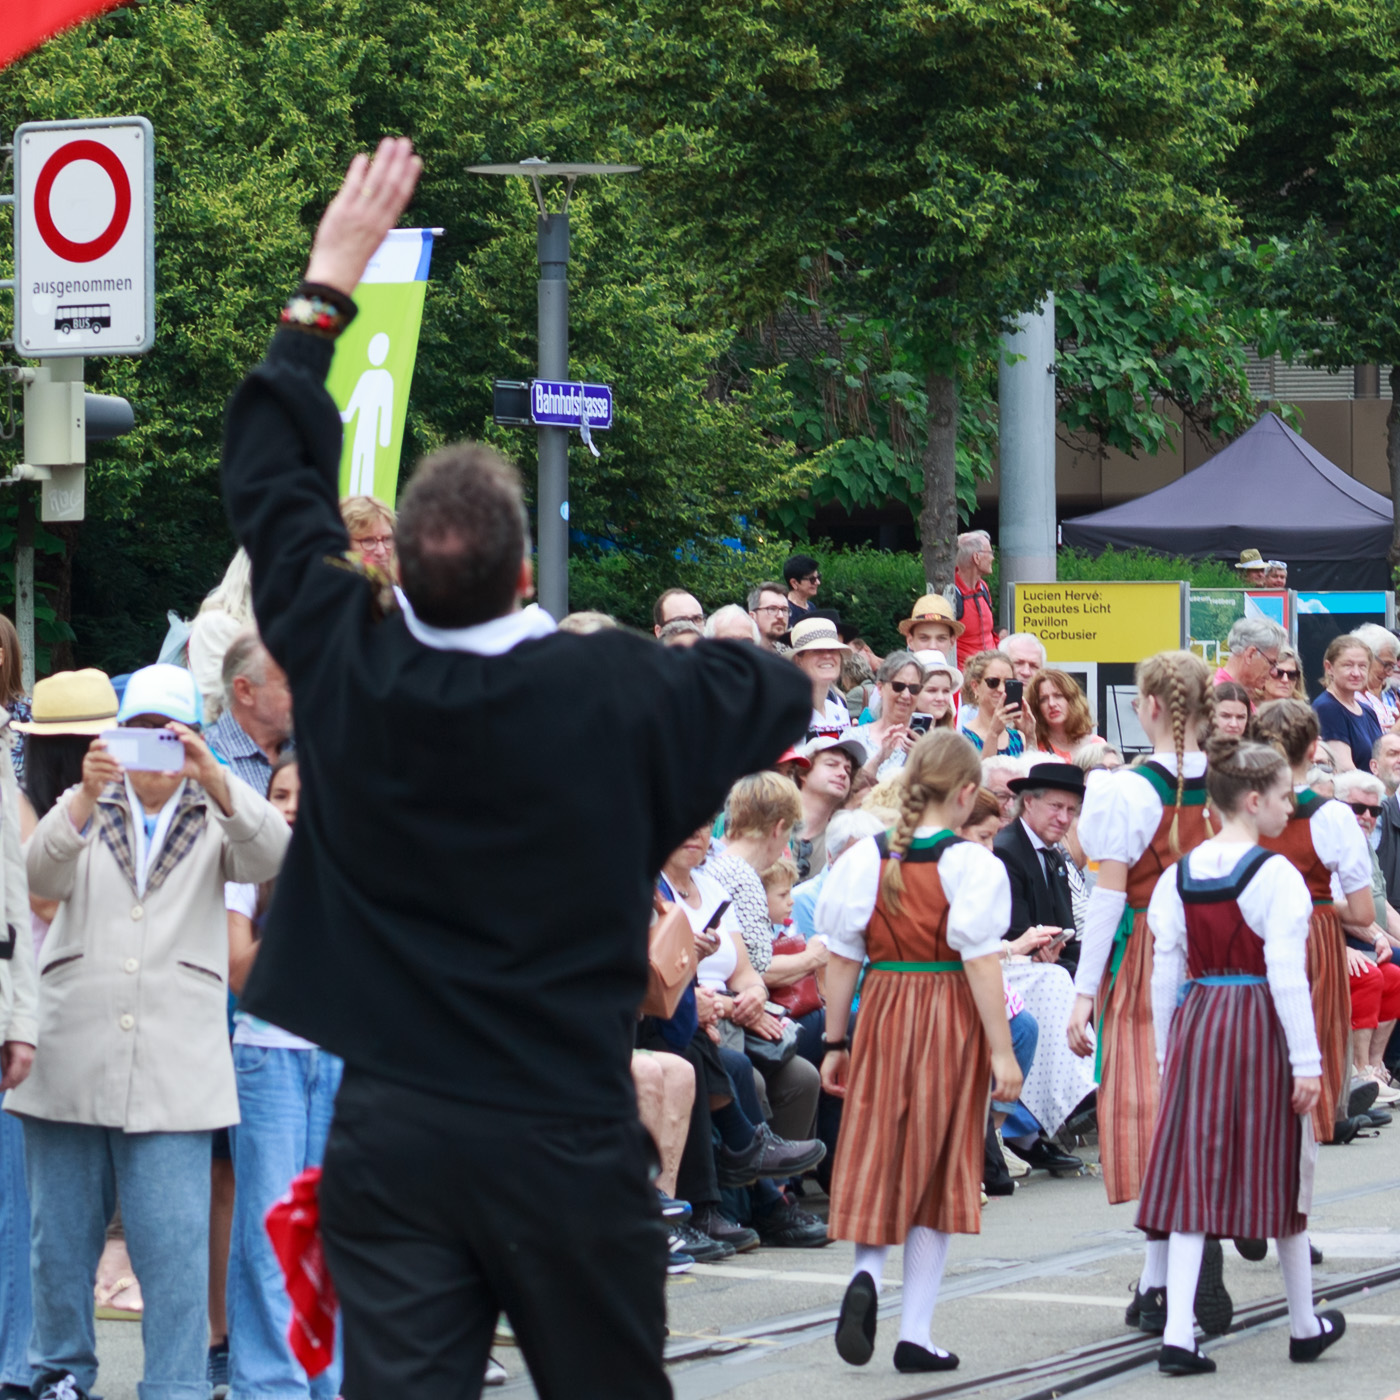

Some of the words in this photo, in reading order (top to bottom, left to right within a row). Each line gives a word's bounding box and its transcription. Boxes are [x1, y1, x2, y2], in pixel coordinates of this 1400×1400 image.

[32, 278, 132, 298] ausgenommen
[72, 318, 91, 329] BUS
[1022, 590, 1061, 601] Lucien
[1064, 589, 1103, 601] Hervé:
[1022, 603, 1080, 614] Gebautes
[1083, 603, 1112, 614] Licht
[1022, 616, 1068, 627] Pavillon
[1040, 629, 1098, 640] Corbusier
